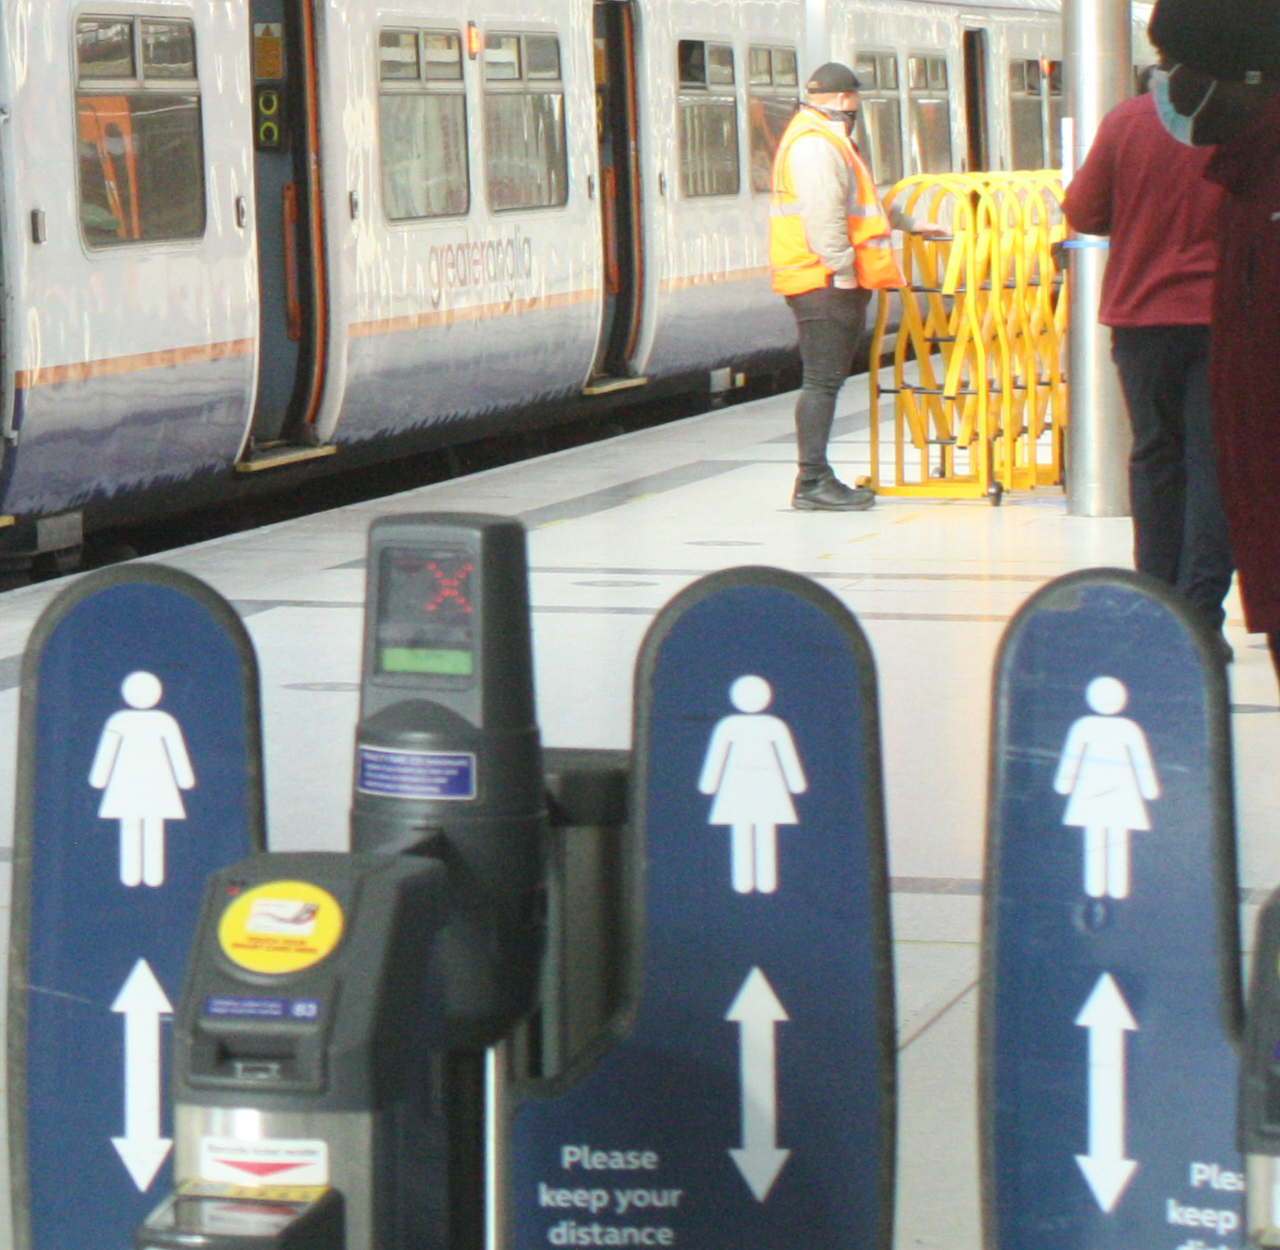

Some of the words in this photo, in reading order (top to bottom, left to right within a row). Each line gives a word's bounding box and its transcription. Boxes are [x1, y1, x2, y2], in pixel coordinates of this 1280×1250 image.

[561, 1144, 659, 1170] Please
[538, 1181, 610, 1214] keep
[612, 1188, 683, 1214] your
[1166, 1198, 1239, 1236] keep
[547, 1219, 675, 1246] distance
